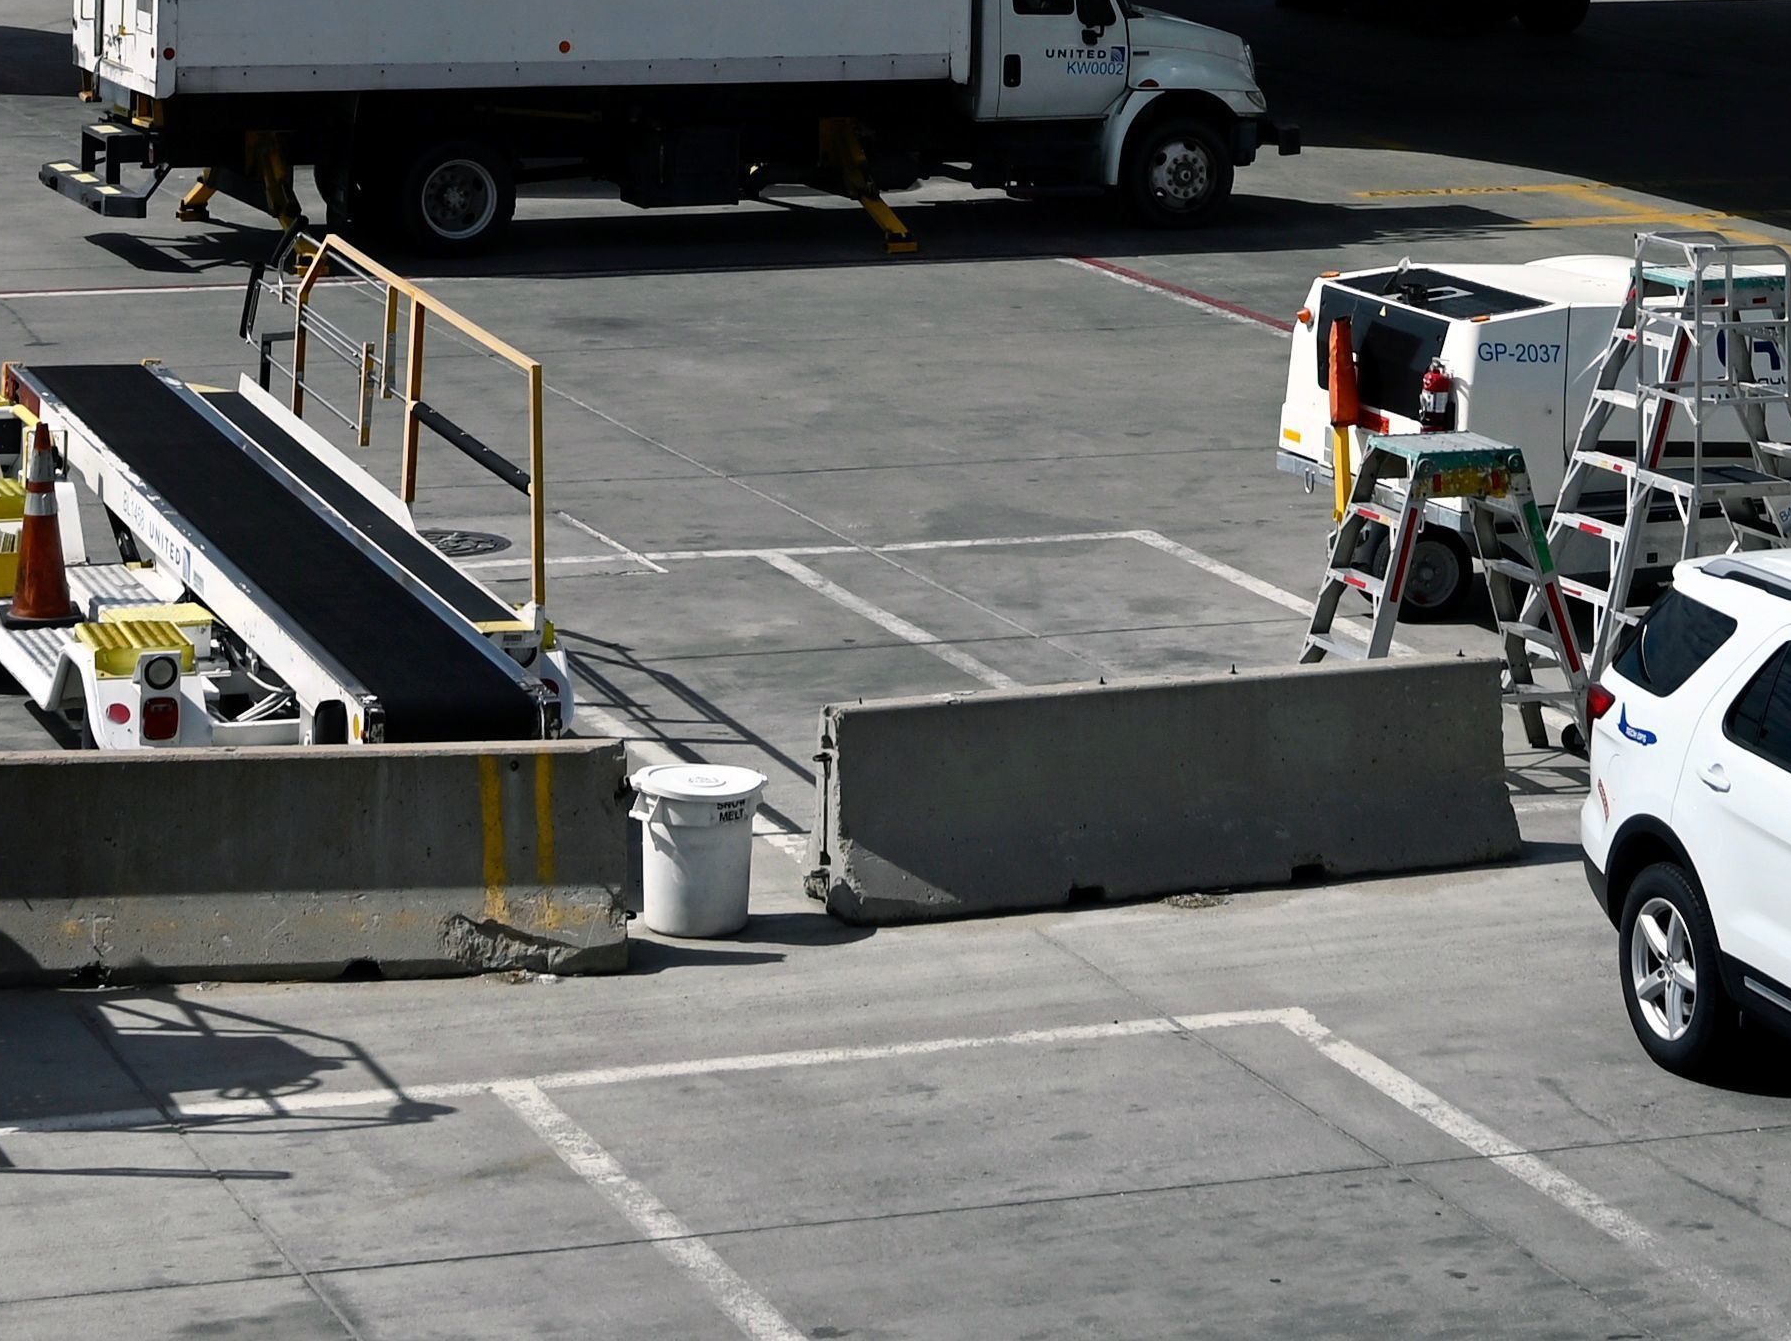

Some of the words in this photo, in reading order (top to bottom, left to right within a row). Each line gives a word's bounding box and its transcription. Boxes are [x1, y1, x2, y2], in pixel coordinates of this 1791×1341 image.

[1045, 49, 1107, 58] UNITED
[1067, 61, 1124, 75] KW0002
[1478, 342, 1561, 363] GP-2037
[149, 520, 182, 565] UNITED
[719, 809, 745, 822] MELT
